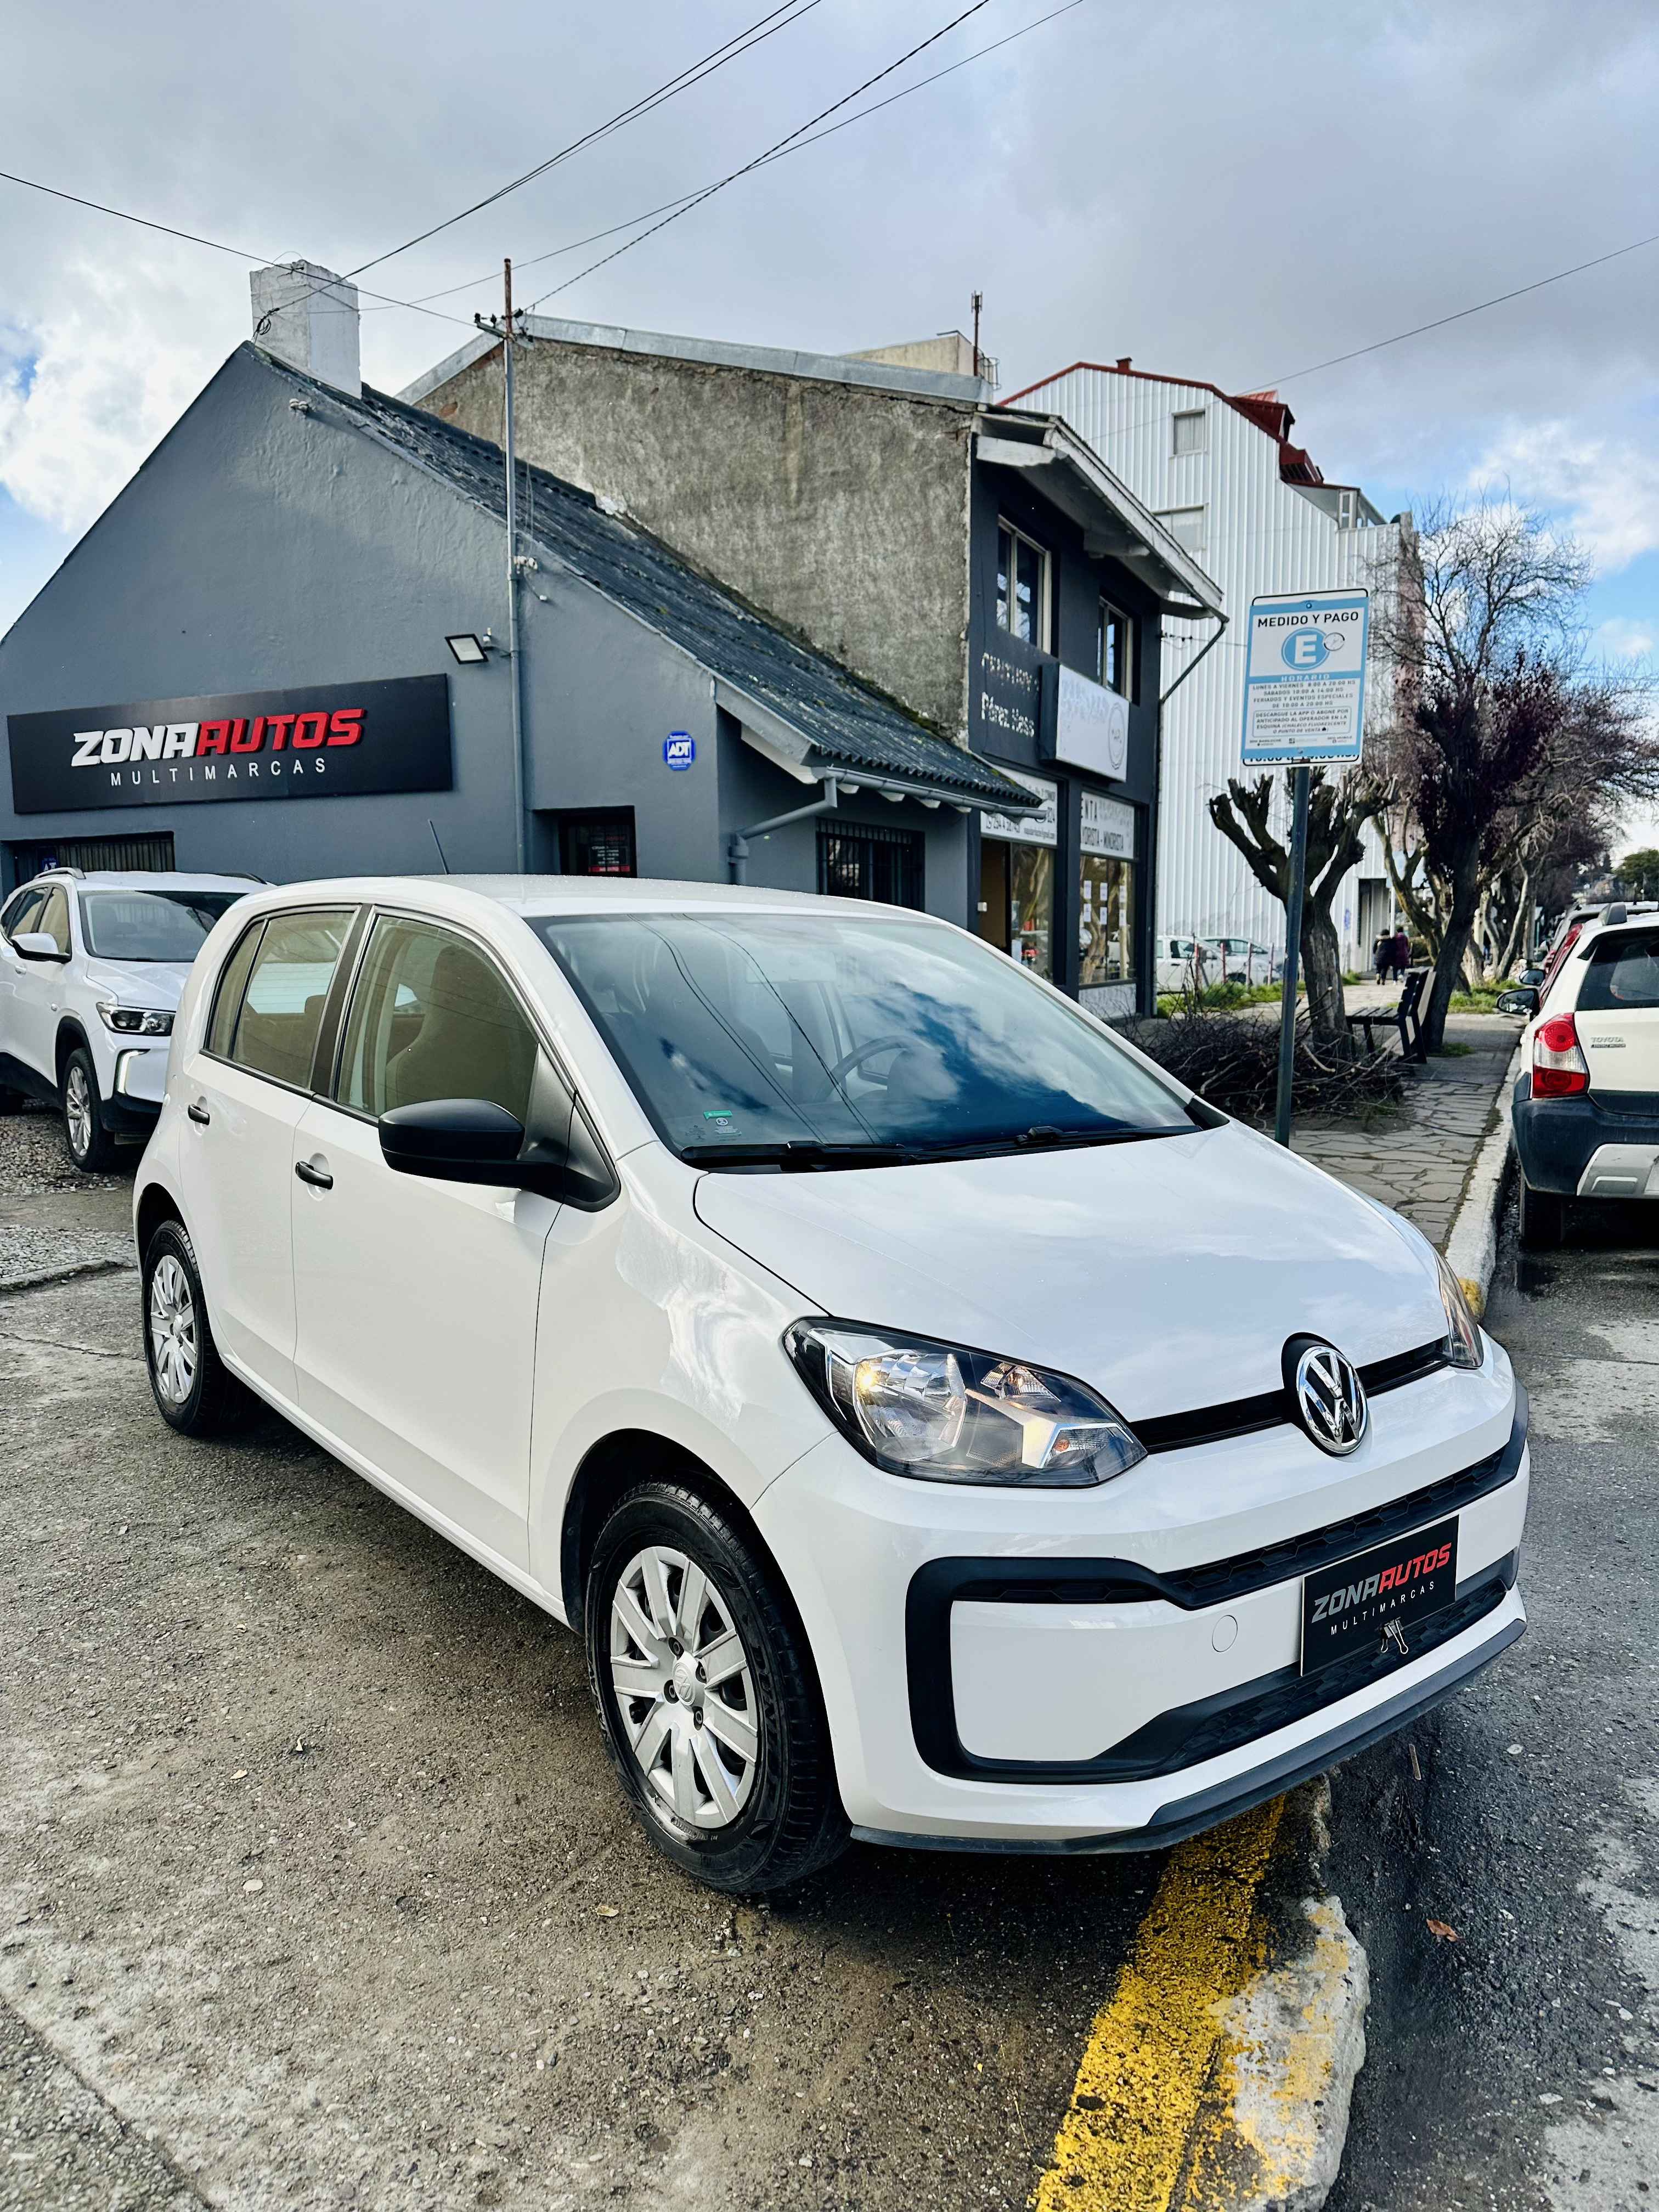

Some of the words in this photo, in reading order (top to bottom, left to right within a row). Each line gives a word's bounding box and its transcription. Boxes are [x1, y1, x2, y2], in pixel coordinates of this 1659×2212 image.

[1257, 615, 1308, 628] MEDIDO
[1312, 614, 1320, 624] Y
[1323, 611, 1358, 623] PAGO
[1294, 634, 1317, 664] E
[1281, 673, 1330, 682] HORARIO
[668, 741, 690, 757] ADT
[110, 757, 326, 787] MULTIMARCAS
[1330, 1581, 1435, 1635] MULTIMARCAS
